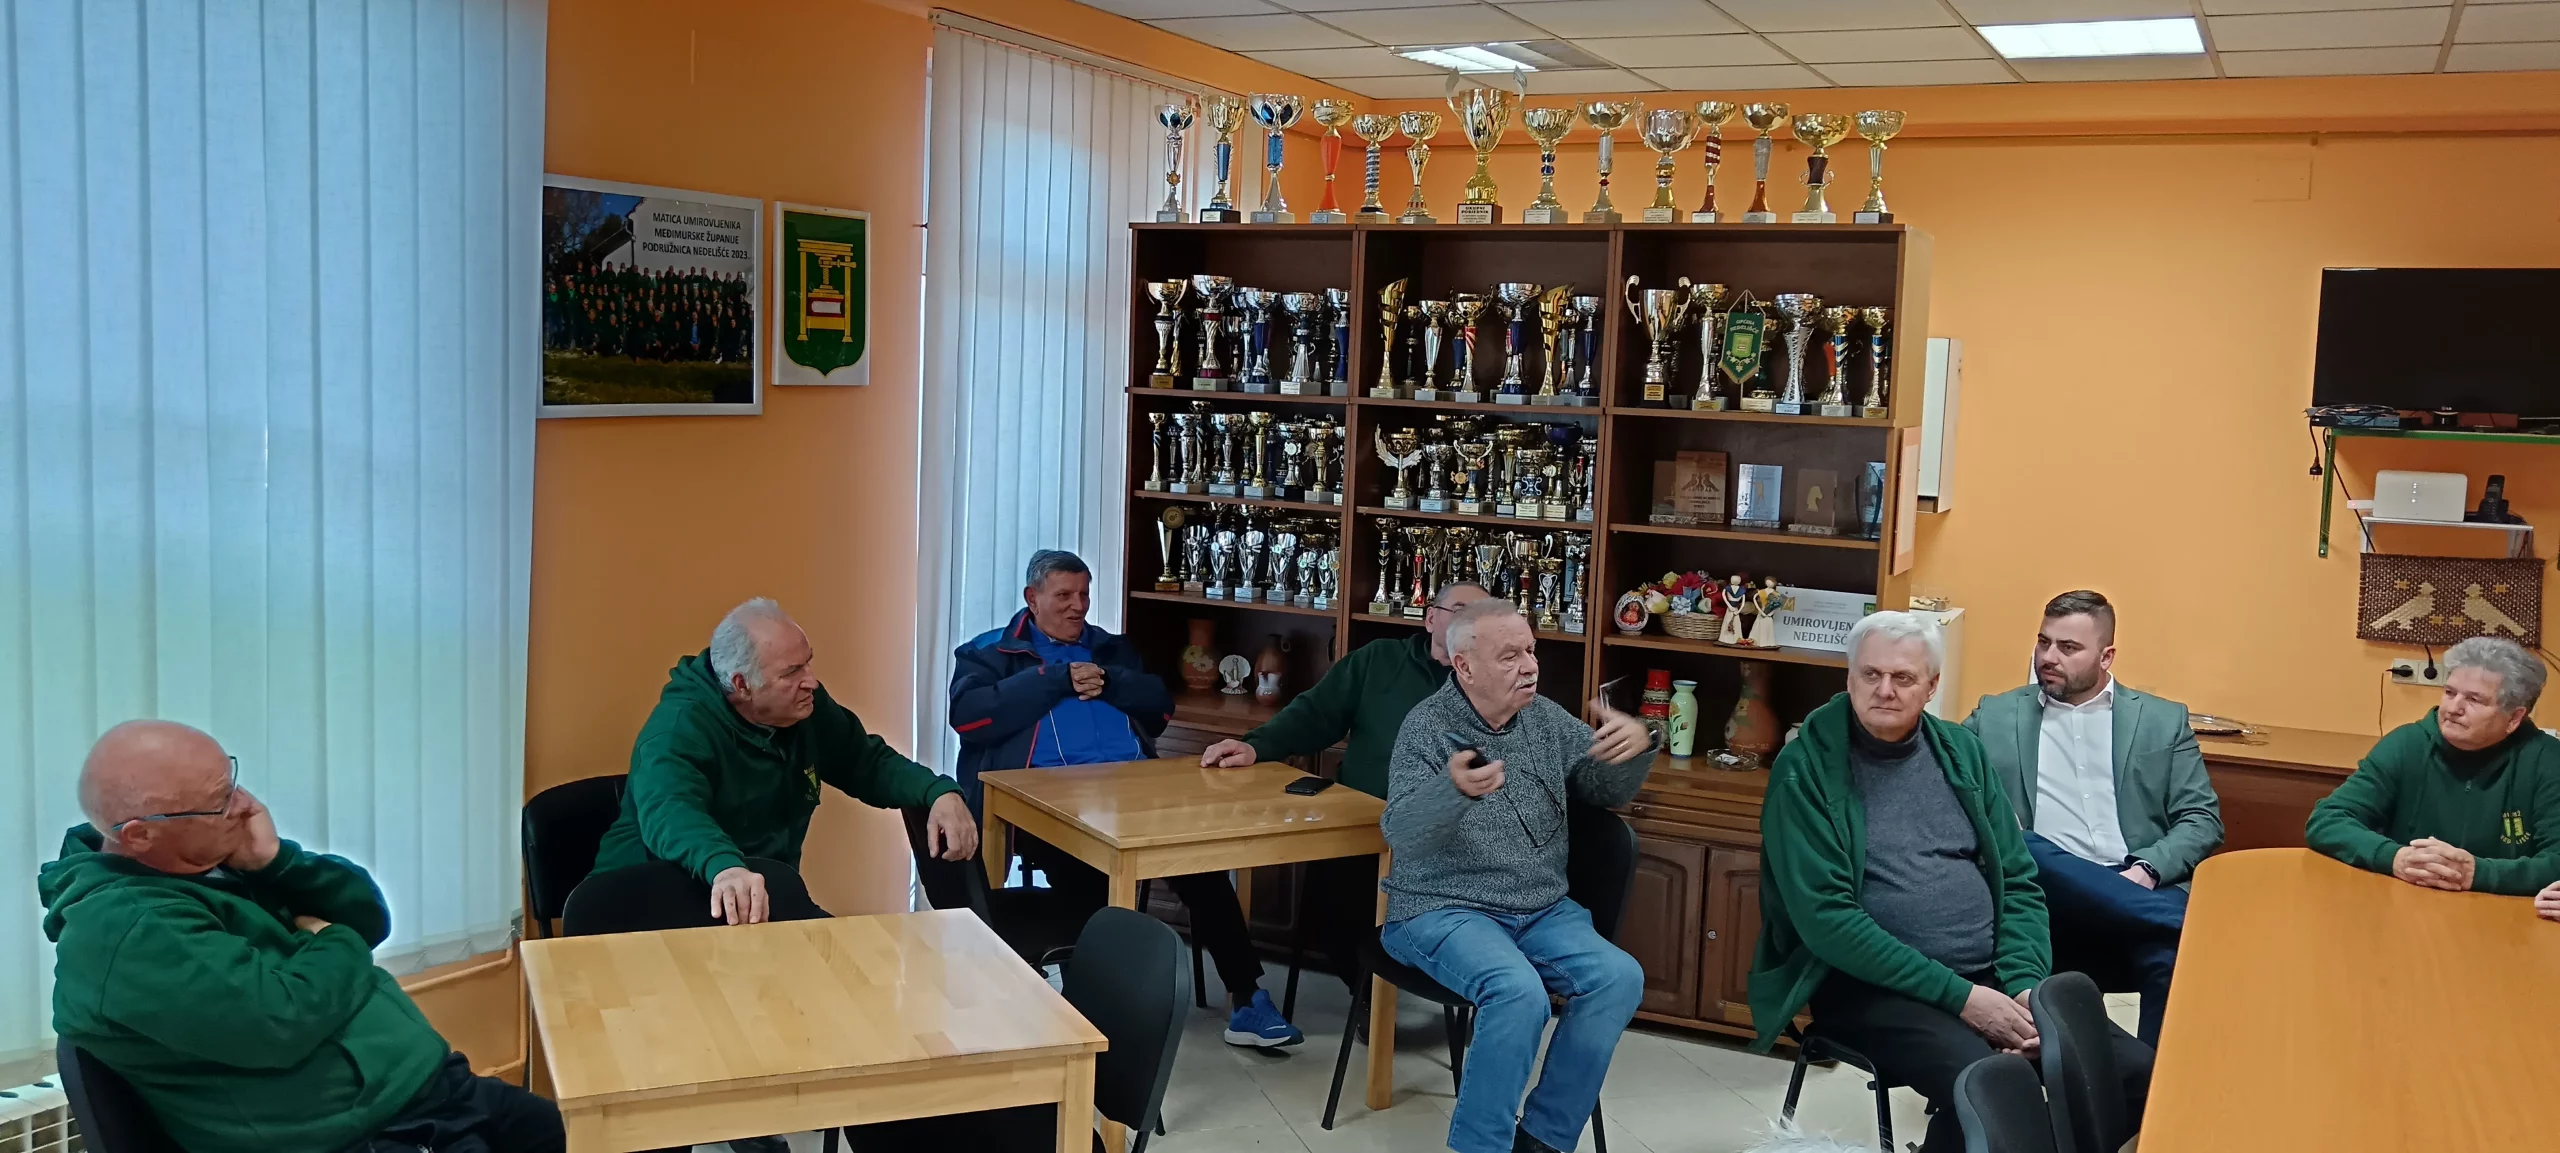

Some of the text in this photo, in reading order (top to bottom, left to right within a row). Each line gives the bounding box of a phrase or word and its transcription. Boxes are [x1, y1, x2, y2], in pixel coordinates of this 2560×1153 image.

[653, 213, 741, 230] MATICA UMIROVLJENIKA
[654, 228, 739, 244] MEĐIMURSKE ŽUPANIJE
[643, 242, 750, 260] PODRUŽNICA NEDELIŠĆE 2023.
[1783, 616, 1855, 632] UMIROVLJEN
[1793, 631, 1848, 646] NEDELIŠĆ
